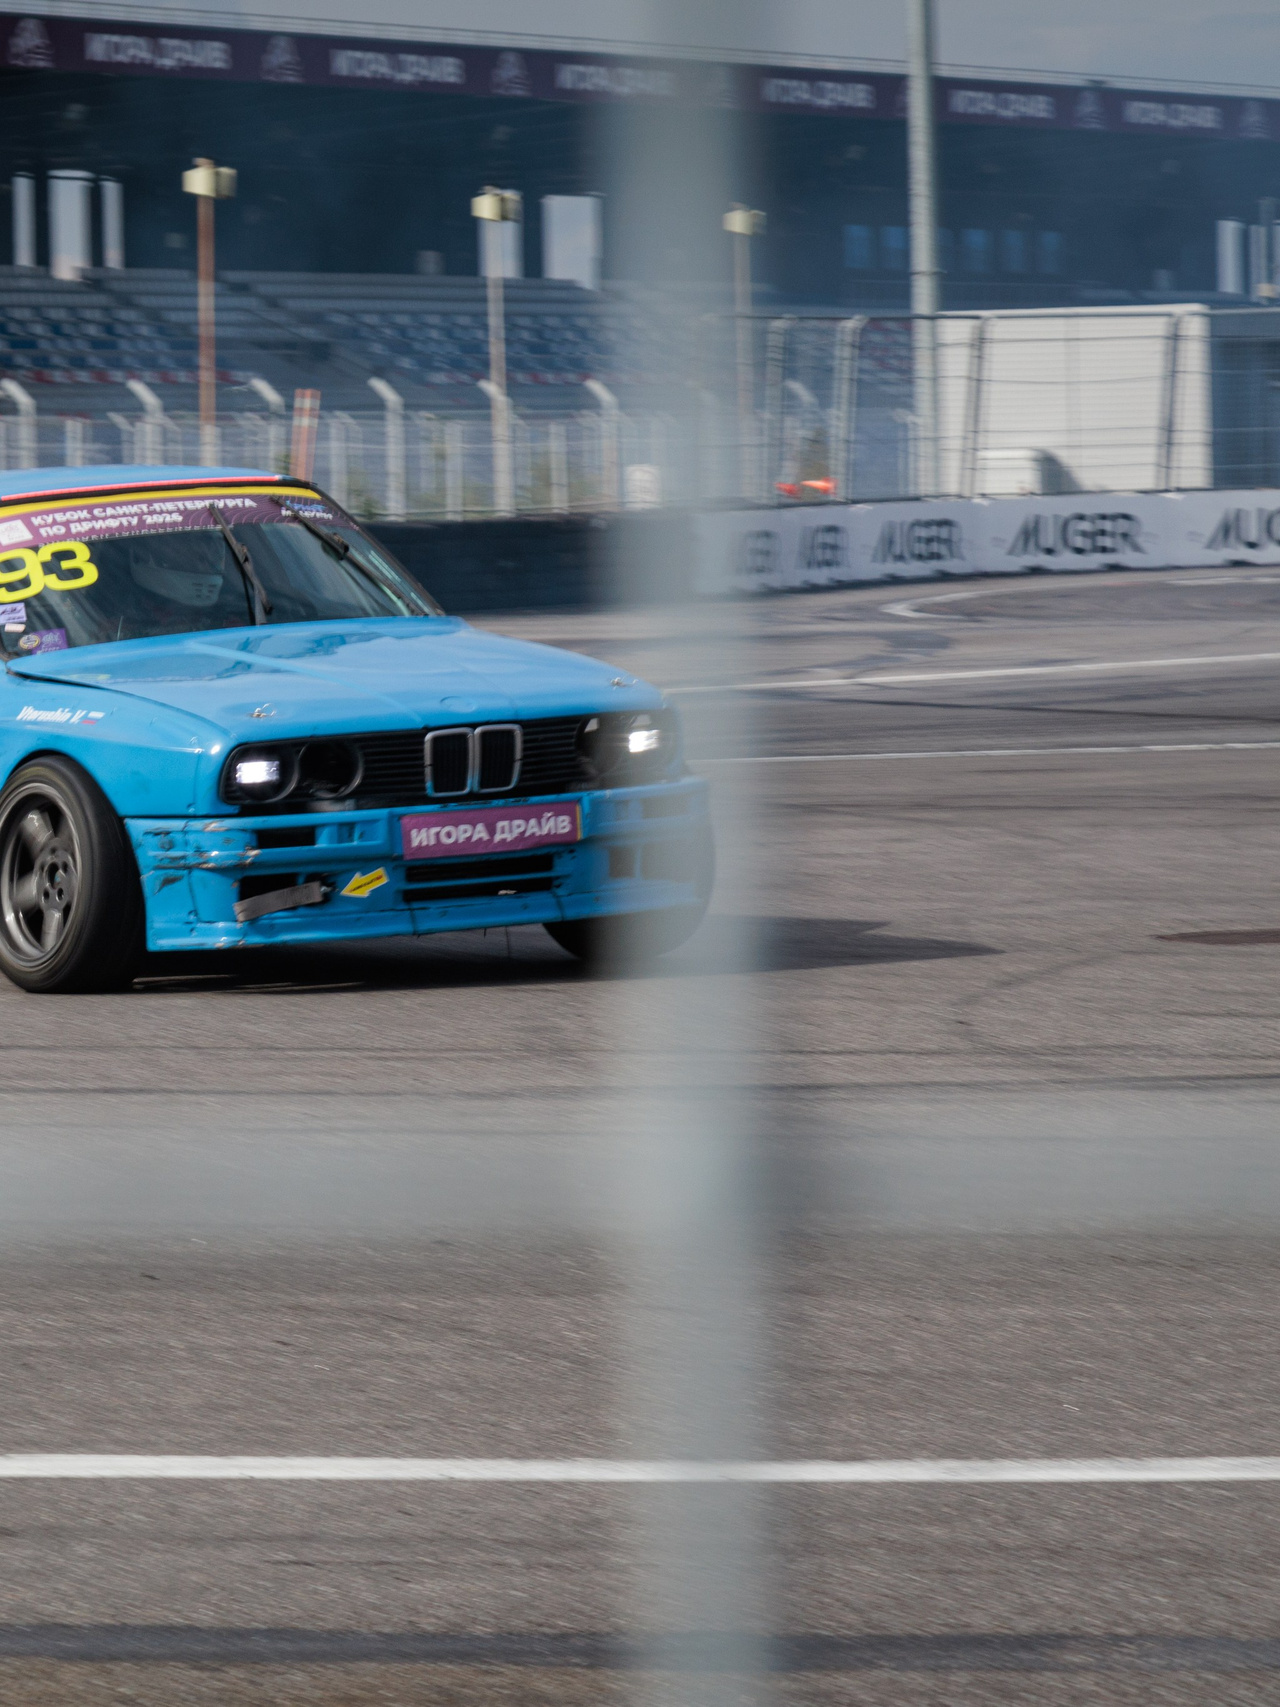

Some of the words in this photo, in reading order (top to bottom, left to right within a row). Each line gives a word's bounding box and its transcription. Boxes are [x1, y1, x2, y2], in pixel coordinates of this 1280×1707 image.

[30, 509, 92, 527] КУБОК
[38, 524, 67, 538] ПО
[69, 515, 139, 535] ДРИФТУ
[410, 823, 490, 848] ИГОРА
[493, 812, 572, 844] ДРАЙВ
